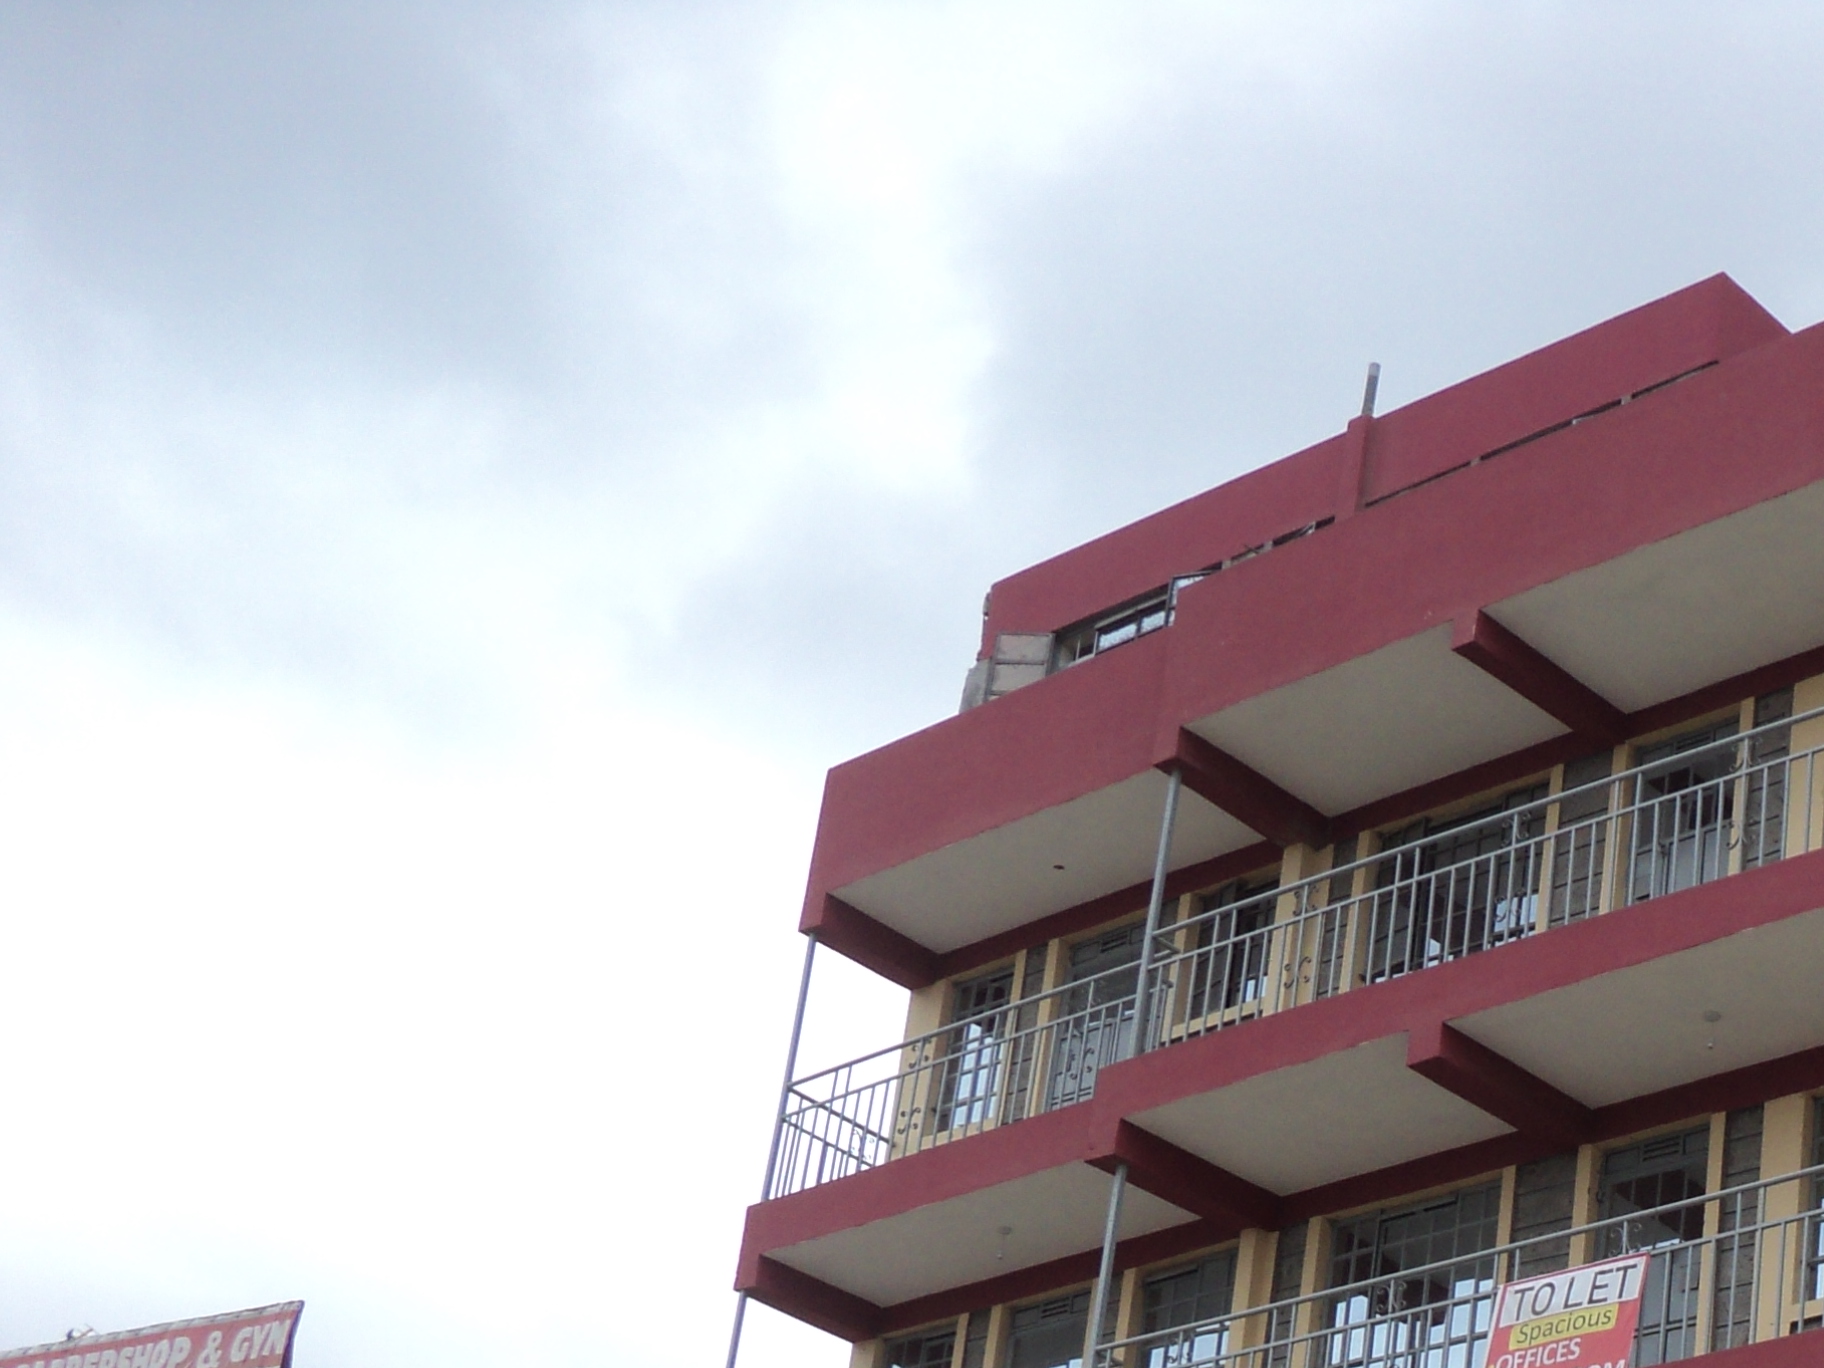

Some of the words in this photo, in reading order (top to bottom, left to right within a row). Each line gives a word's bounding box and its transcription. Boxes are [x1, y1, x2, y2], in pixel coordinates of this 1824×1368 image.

[1514, 1281, 1556, 1322] TO
[1565, 1263, 1639, 1311] LET
[1516, 1306, 1613, 1345] Spacious
